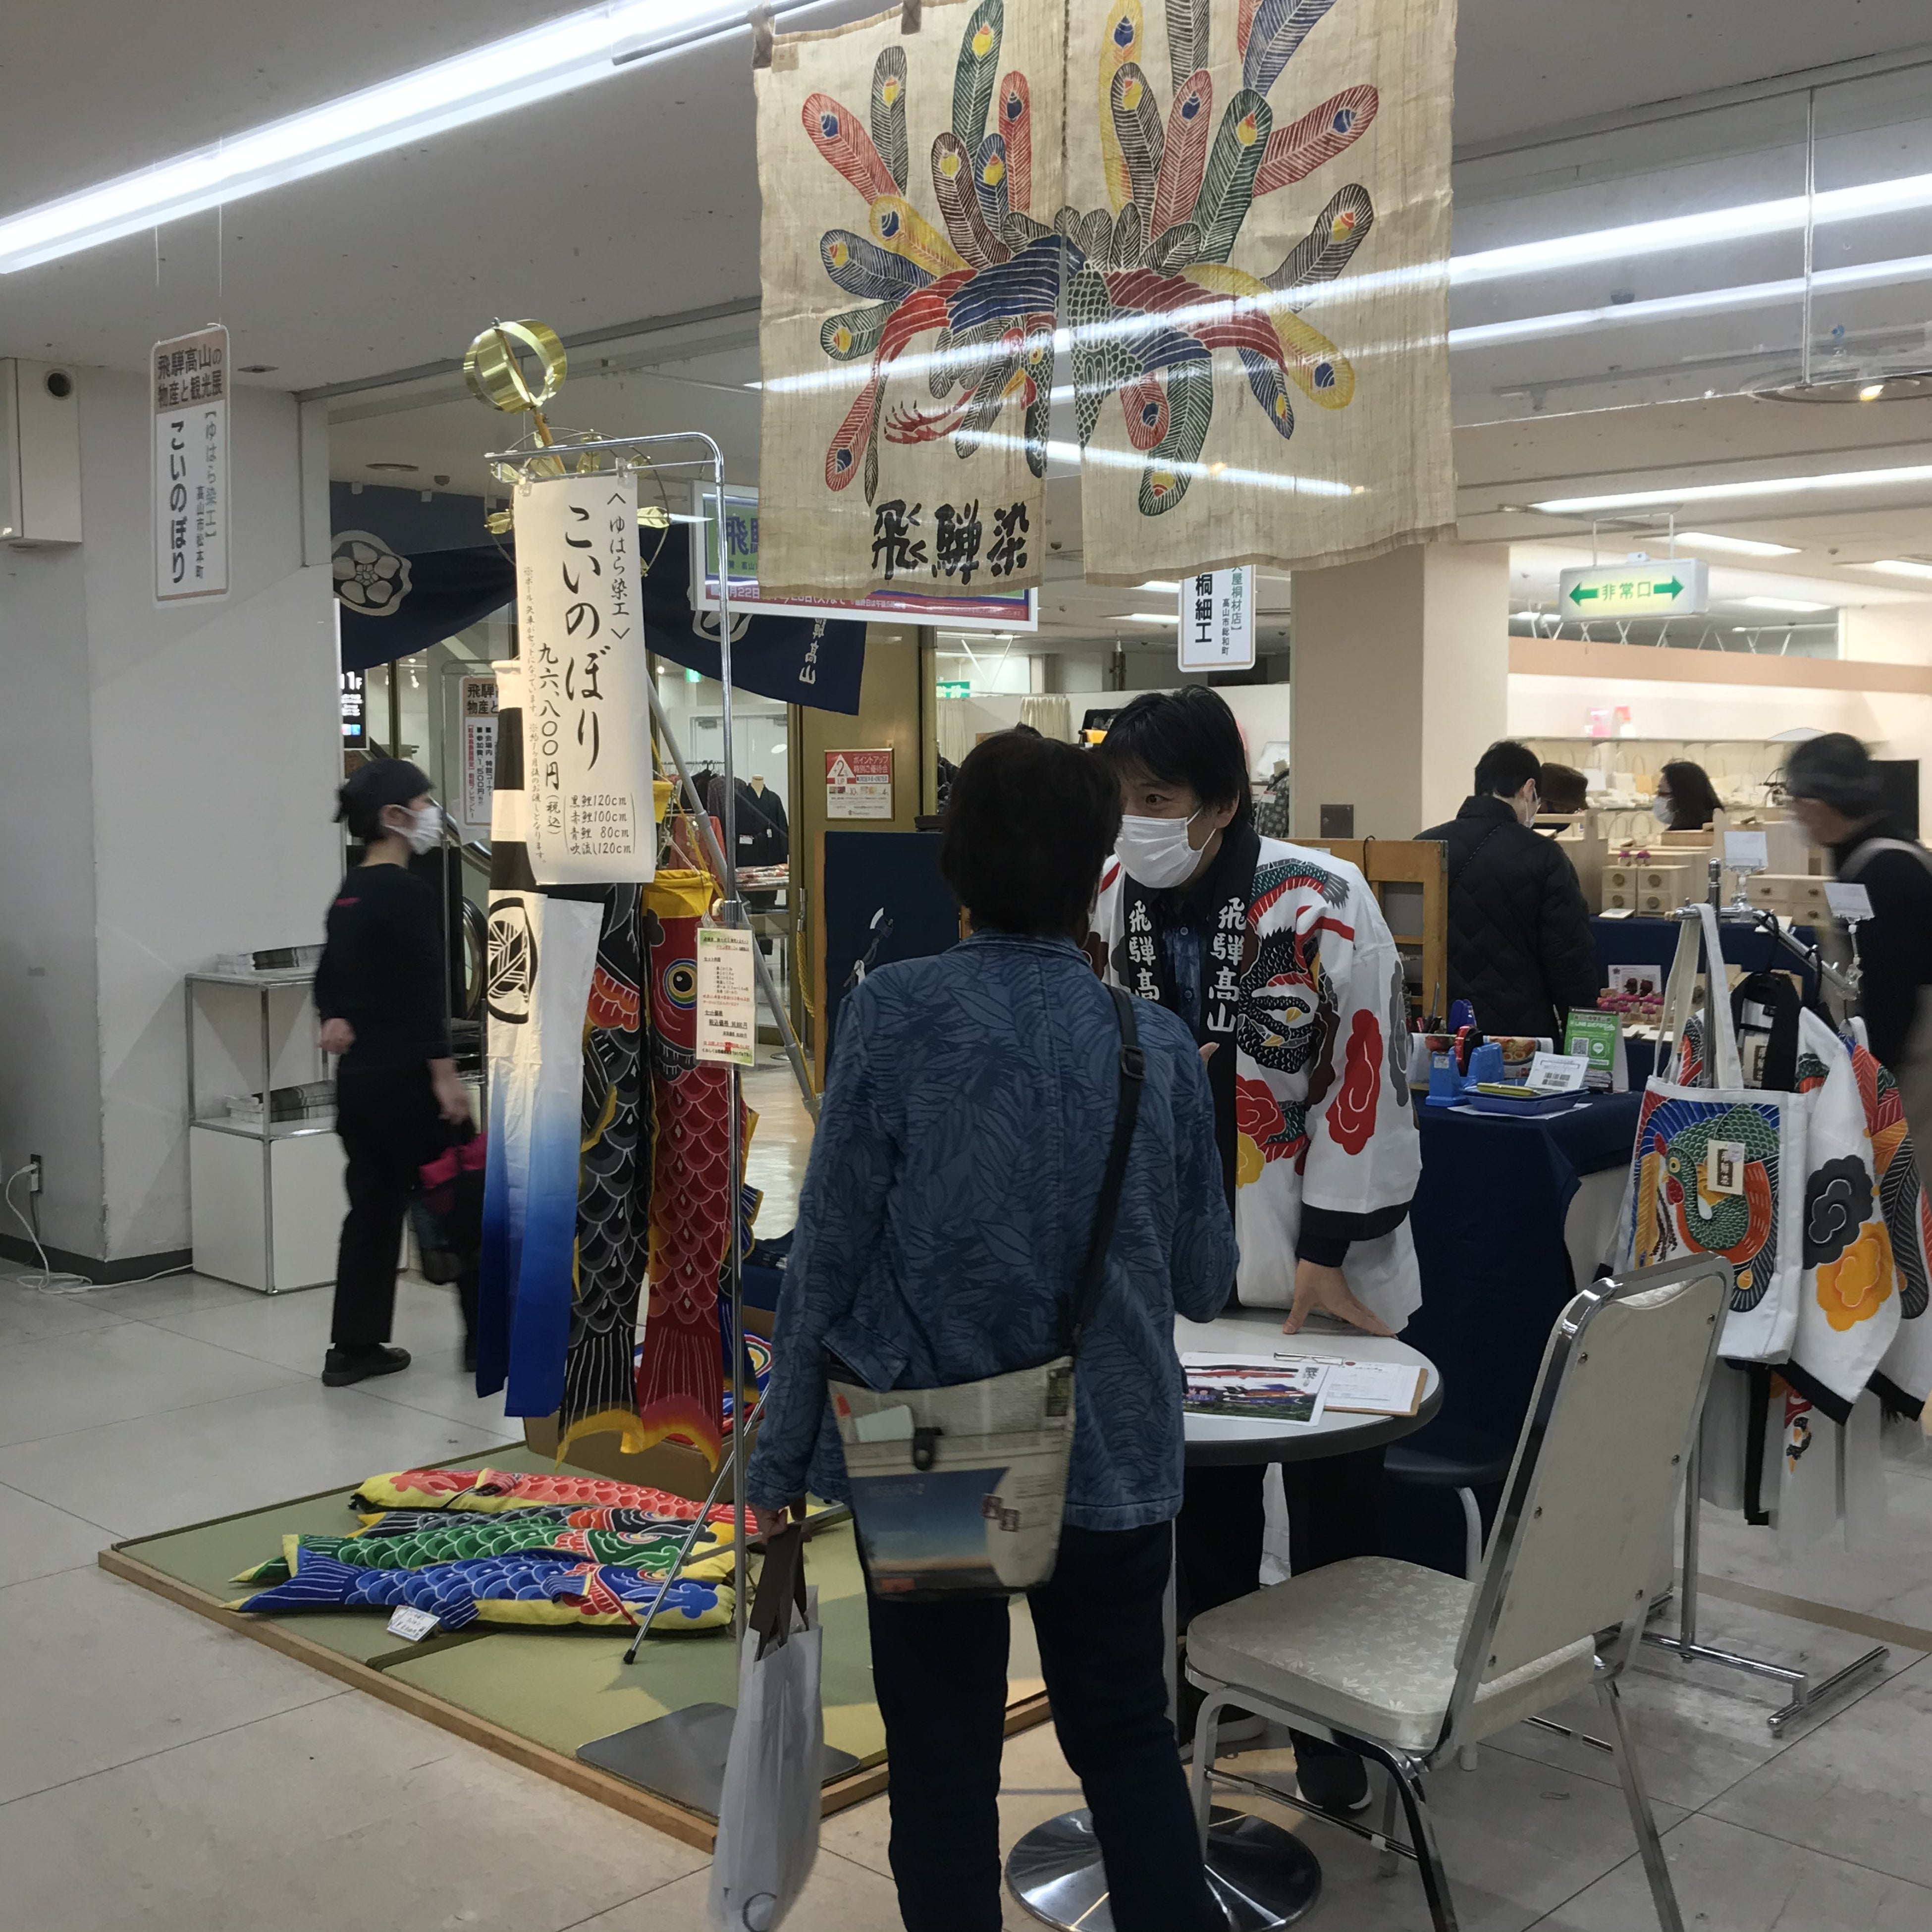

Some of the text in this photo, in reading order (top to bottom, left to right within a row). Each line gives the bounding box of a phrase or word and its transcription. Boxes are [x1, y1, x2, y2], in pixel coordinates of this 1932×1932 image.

[158, 344, 222, 380] 飛騨高山の
[169, 421, 188, 584] こいのぼり
[872, 498, 1030, 585] 飛騨染
[1602, 581, 1651, 601] 非常口
[562, 505, 611, 771] こいのぼり
[467, 683, 499, 698] 飛騨
[1207, 897, 1247, 1032] 飛騨高山
